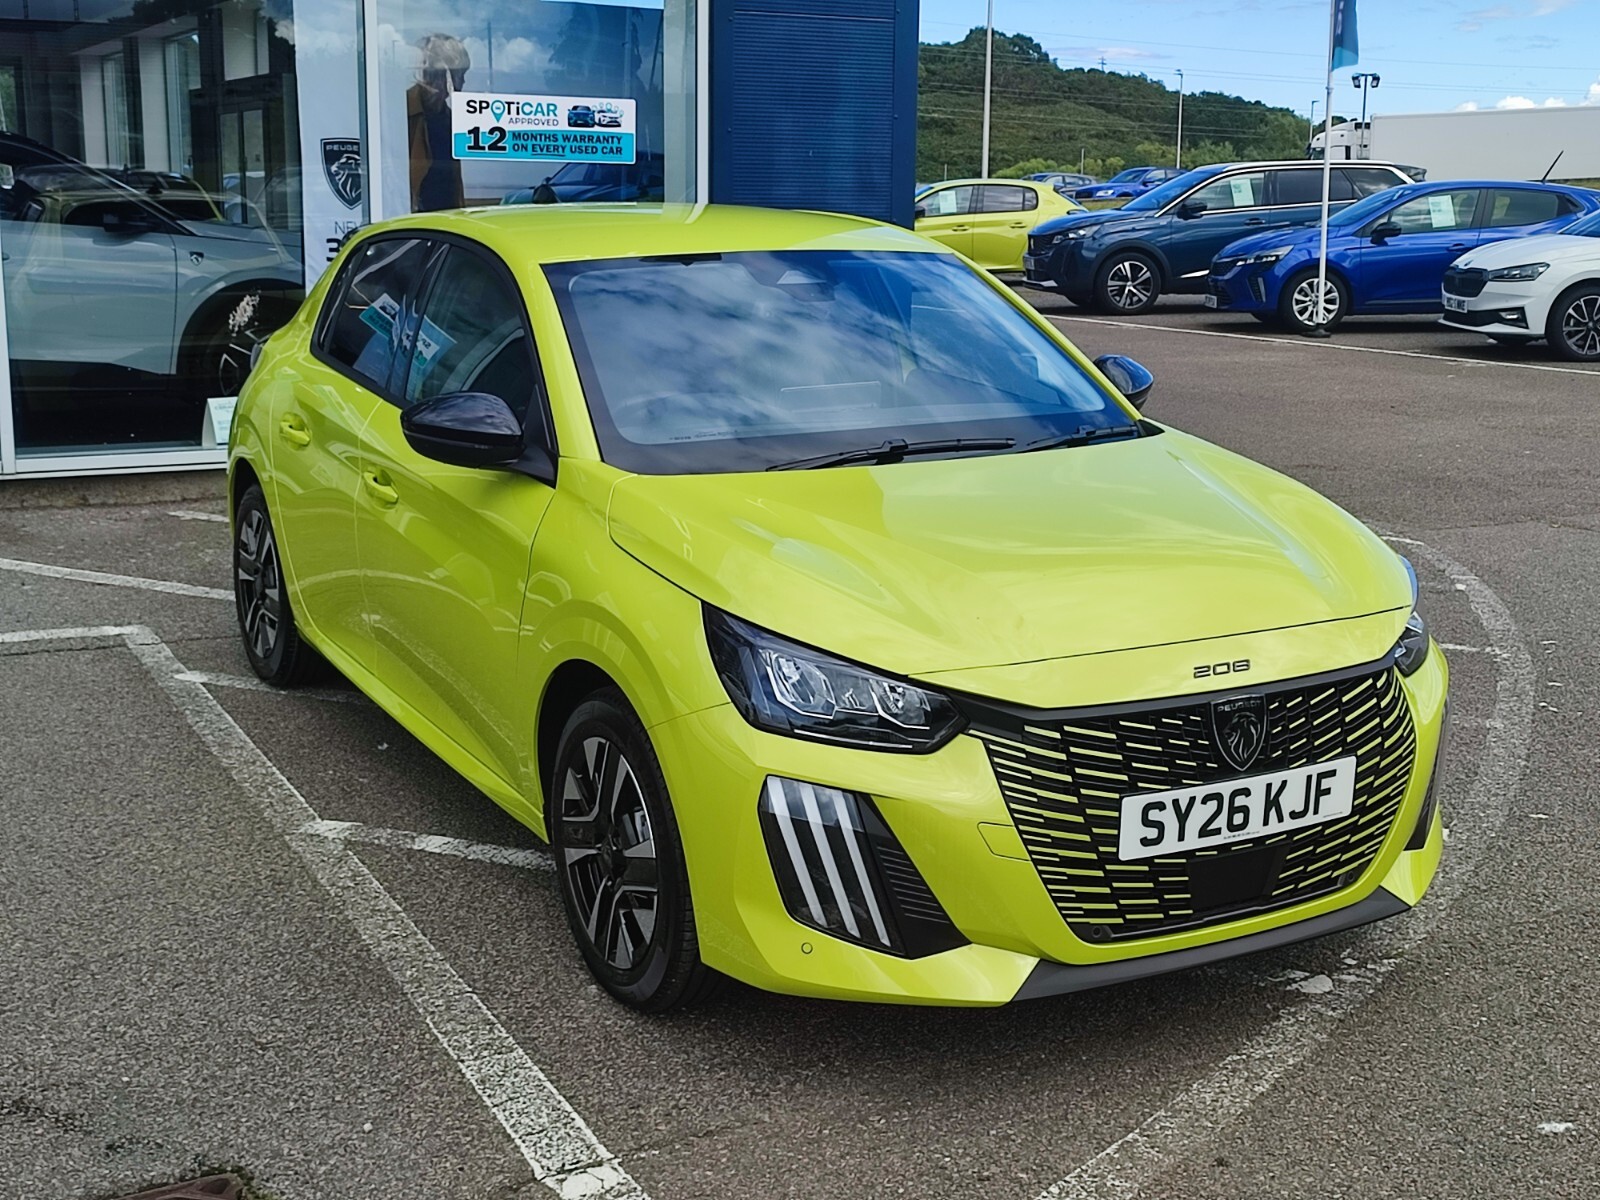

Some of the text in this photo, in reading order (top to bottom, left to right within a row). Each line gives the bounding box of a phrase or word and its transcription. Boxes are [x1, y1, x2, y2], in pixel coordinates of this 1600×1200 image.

[508, 117, 559, 126] APPROVED
[466, 126, 507, 151] 12
[511, 131, 623, 145] MONTHS WARRANTY
[512, 143, 623, 155] ON EVERY USED CAR
[1193, 659, 1250, 679] 208
[1139, 768, 1337, 847] SY26 KJF
